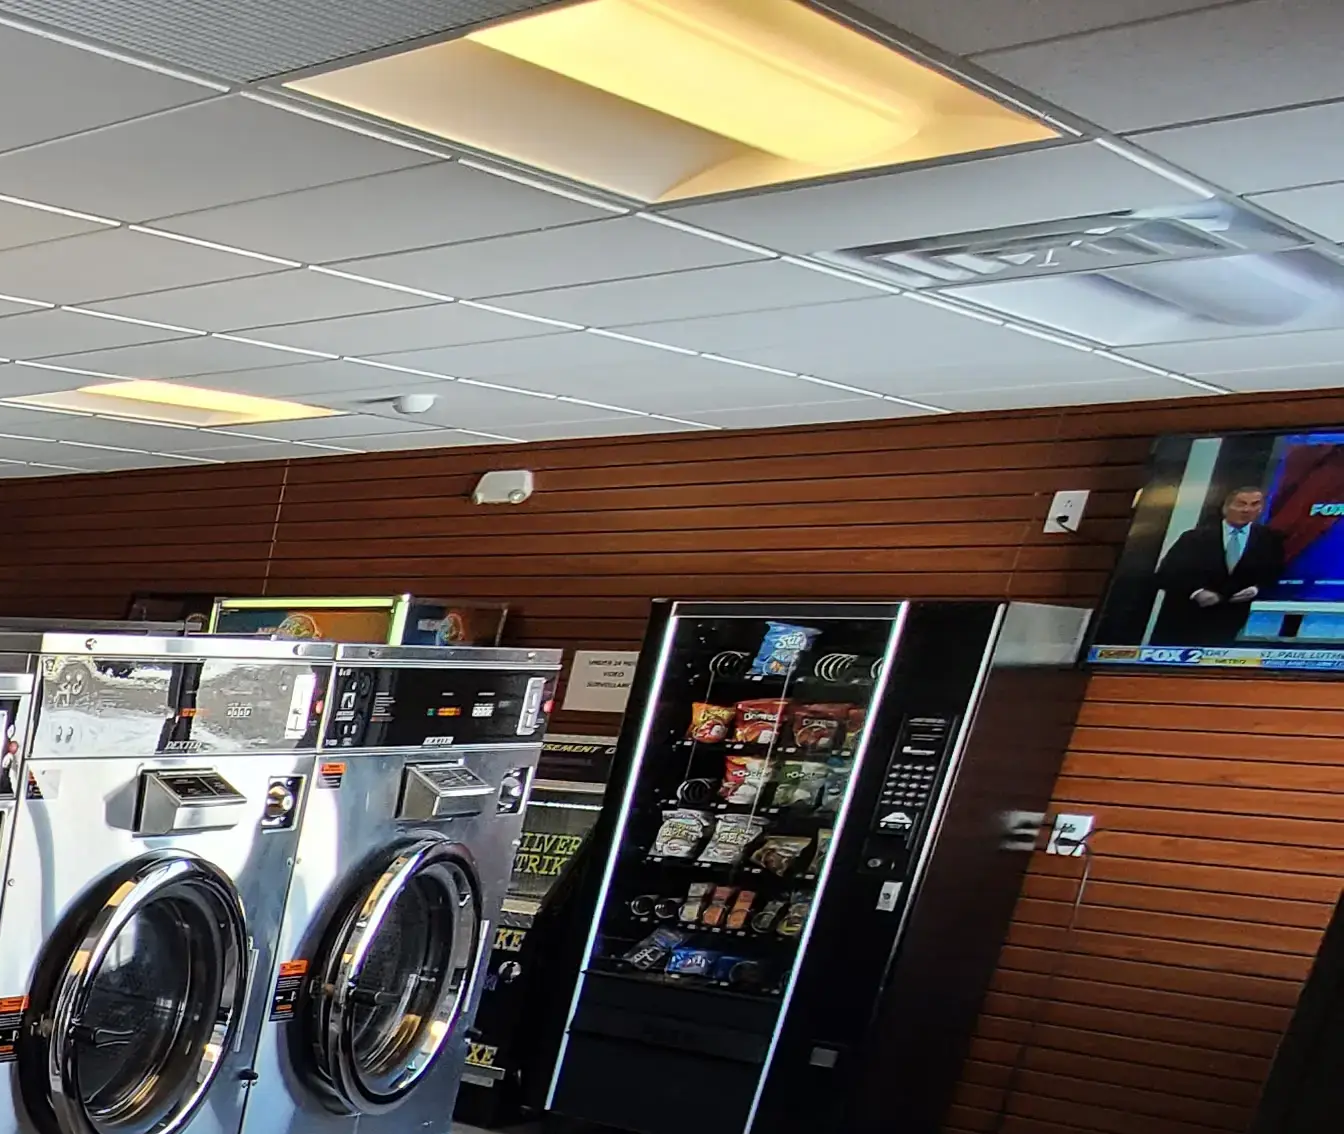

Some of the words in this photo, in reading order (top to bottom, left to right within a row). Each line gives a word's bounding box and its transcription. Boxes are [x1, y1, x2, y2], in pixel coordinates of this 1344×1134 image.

[1140, 650, 1178, 664] FOX
[1184, 649, 1204, 664] 2
[164, 741, 202, 750] DEXTER
[423, 736, 454, 746] DEXTER
[542, 742, 602, 754] SEMENT
[518, 832, 582, 855] ILVER
[514, 854, 571, 876] TRIK
[493, 928, 526, 952] KE
[465, 1042, 498, 1066] XE
